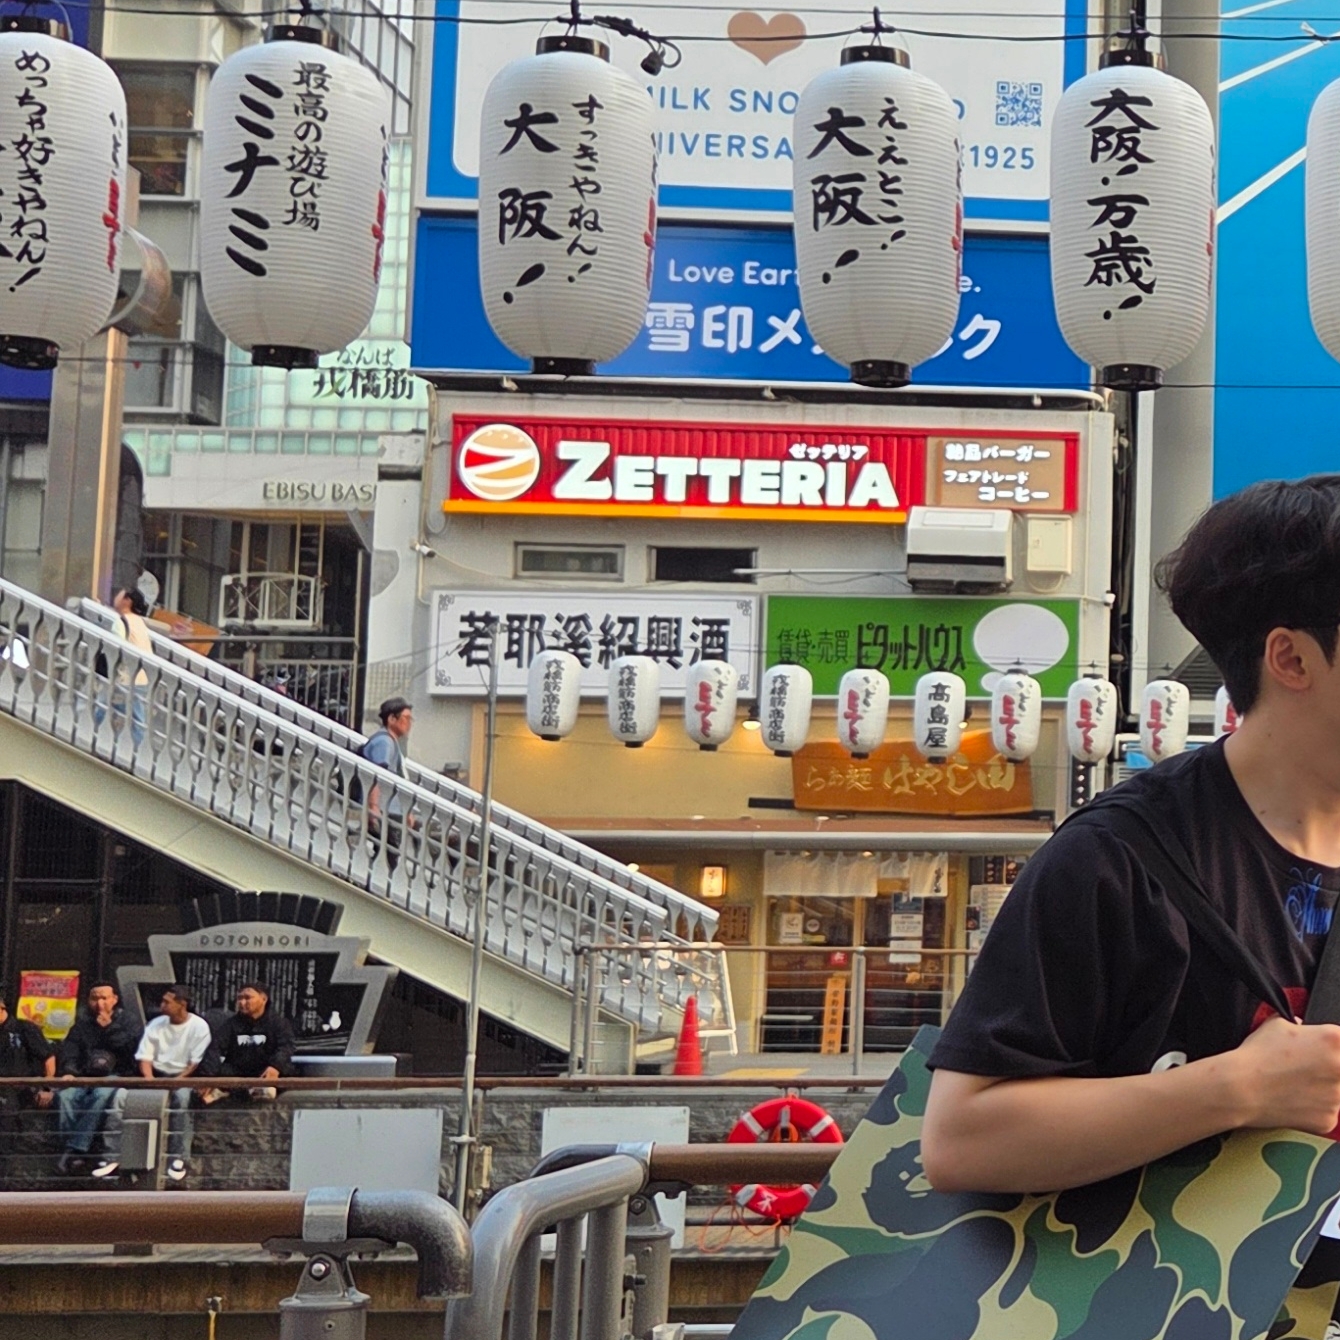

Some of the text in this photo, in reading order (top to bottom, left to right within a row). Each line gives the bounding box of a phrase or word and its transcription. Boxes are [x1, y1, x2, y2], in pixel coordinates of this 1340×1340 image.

[648, 85, 798, 114] ILK SNO
[282, 61, 332, 231] 最高の遊び場
[656, 131, 1035, 169] IVERSA 1925
[223, 74, 284, 277] ミナミ
[567, 94, 604, 283] すっきやねん！
[876, 97, 909, 251] ええとこ！
[498, 102, 565, 304] 大阪！
[806, 106, 881, 284] 大阪！
[668, 259, 798, 286] Love Ear
[645, 301, 1001, 361] 雪印メク
[337, 346, 394, 367] なんば
[312, 367, 415, 400] 戎橋筋
[789, 443, 868, 460] ゼッテリア
[262, 482, 376, 501] EBISU BAS
[552, 440, 899, 507] ZETTERIA
[943, 470, 1029, 484] フェアトレード
[978, 486, 1050, 502] コーヒー
[857, 622, 966, 672] ピタットハウス
[201, 934, 310, 947] DOTONBORI
